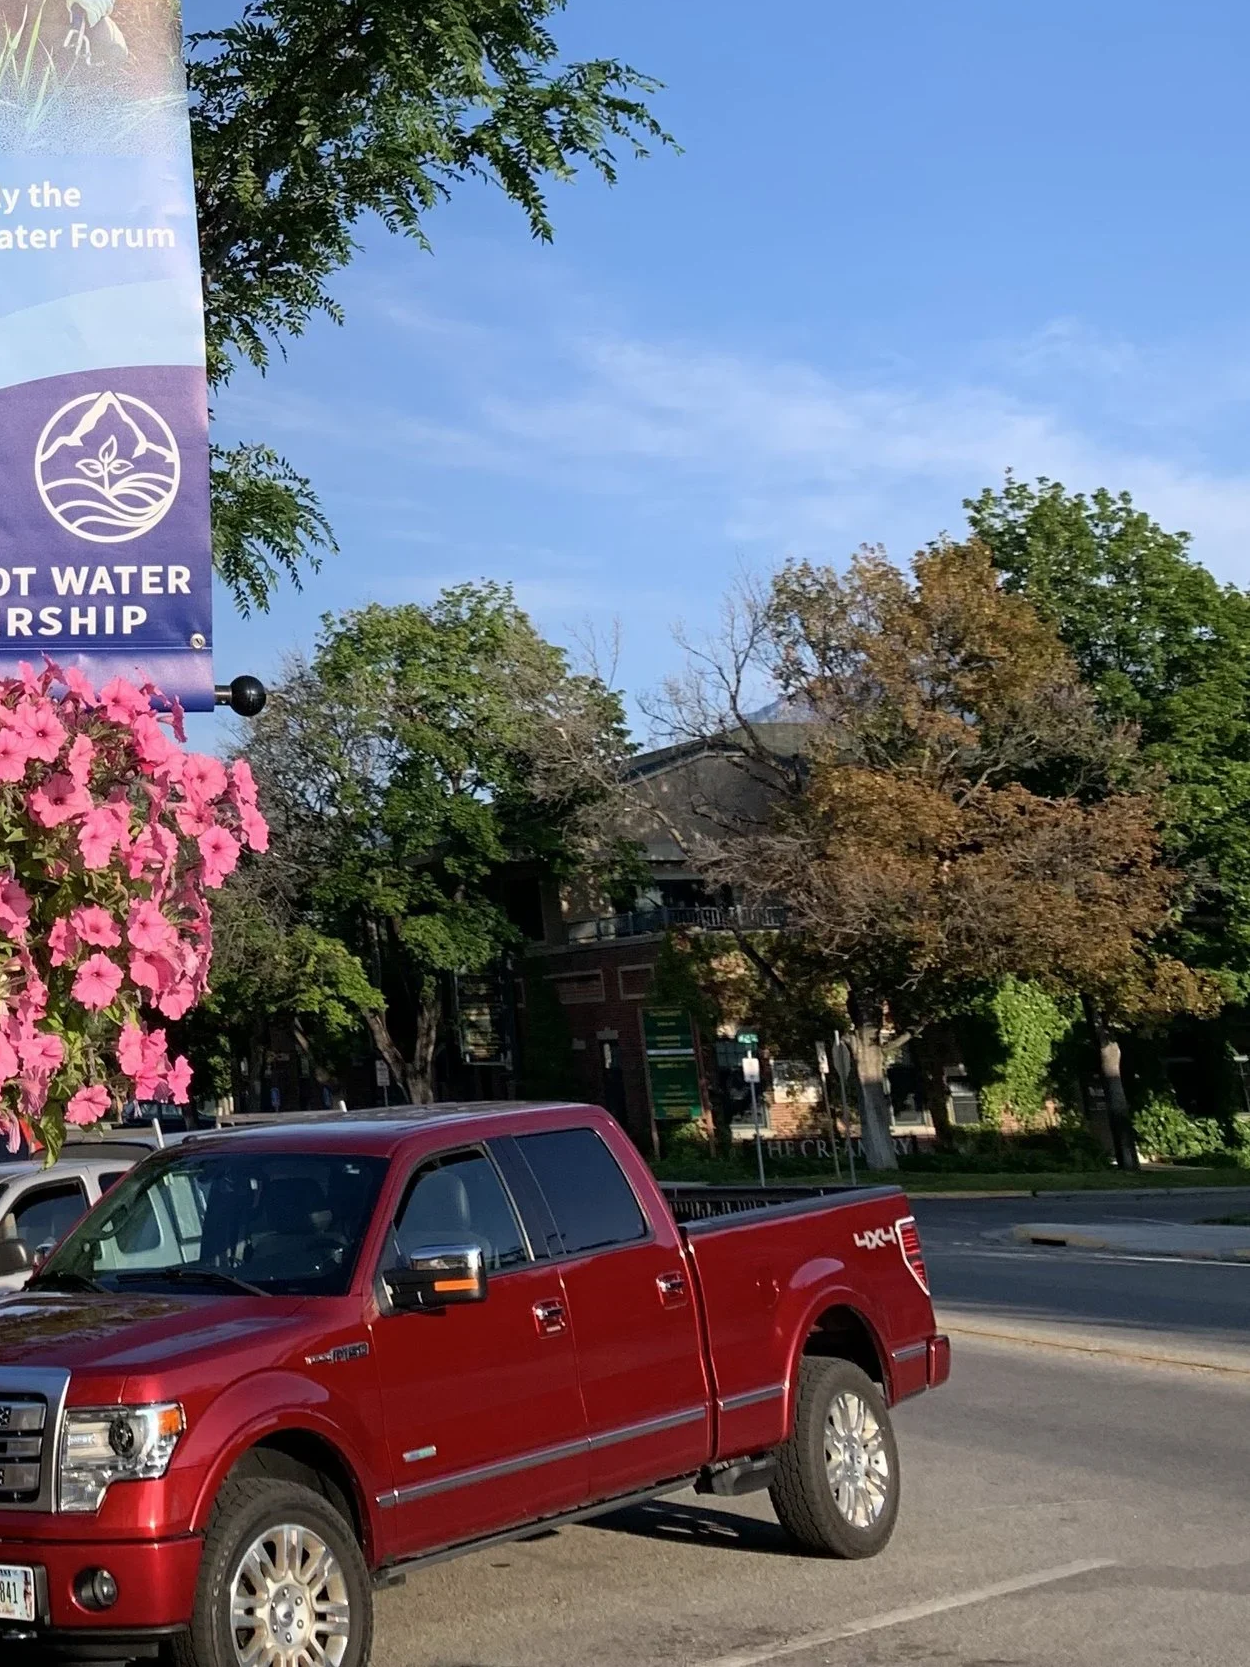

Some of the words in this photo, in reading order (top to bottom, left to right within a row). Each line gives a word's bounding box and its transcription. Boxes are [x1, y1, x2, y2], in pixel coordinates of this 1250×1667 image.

[28, 181, 82, 208] the
[70, 222, 177, 249] Forum
[50, 564, 192, 596] WATER
